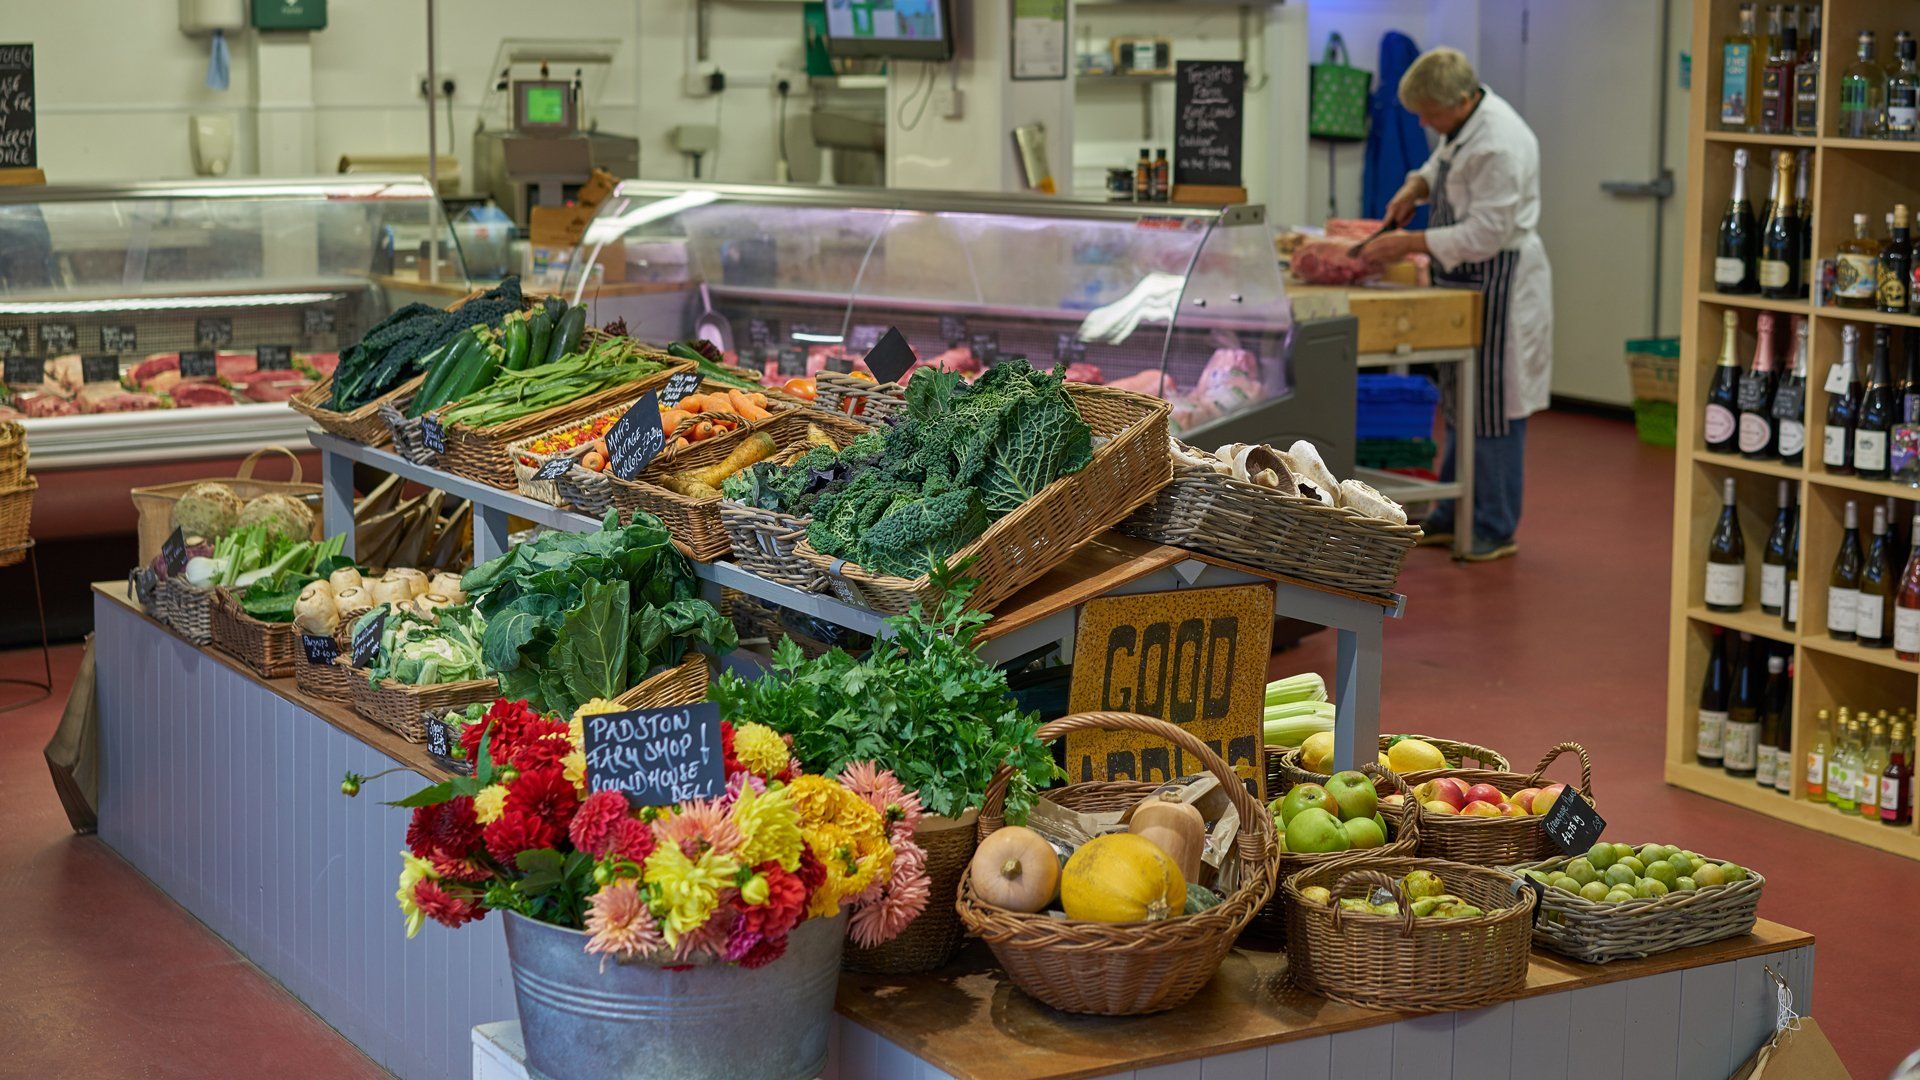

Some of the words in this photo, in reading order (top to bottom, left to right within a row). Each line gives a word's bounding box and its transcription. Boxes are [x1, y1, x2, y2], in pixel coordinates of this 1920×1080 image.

[1101, 616, 1239, 732] GOOD
[586, 743, 647, 774] FARM
[644, 733, 692, 769] SHOP
